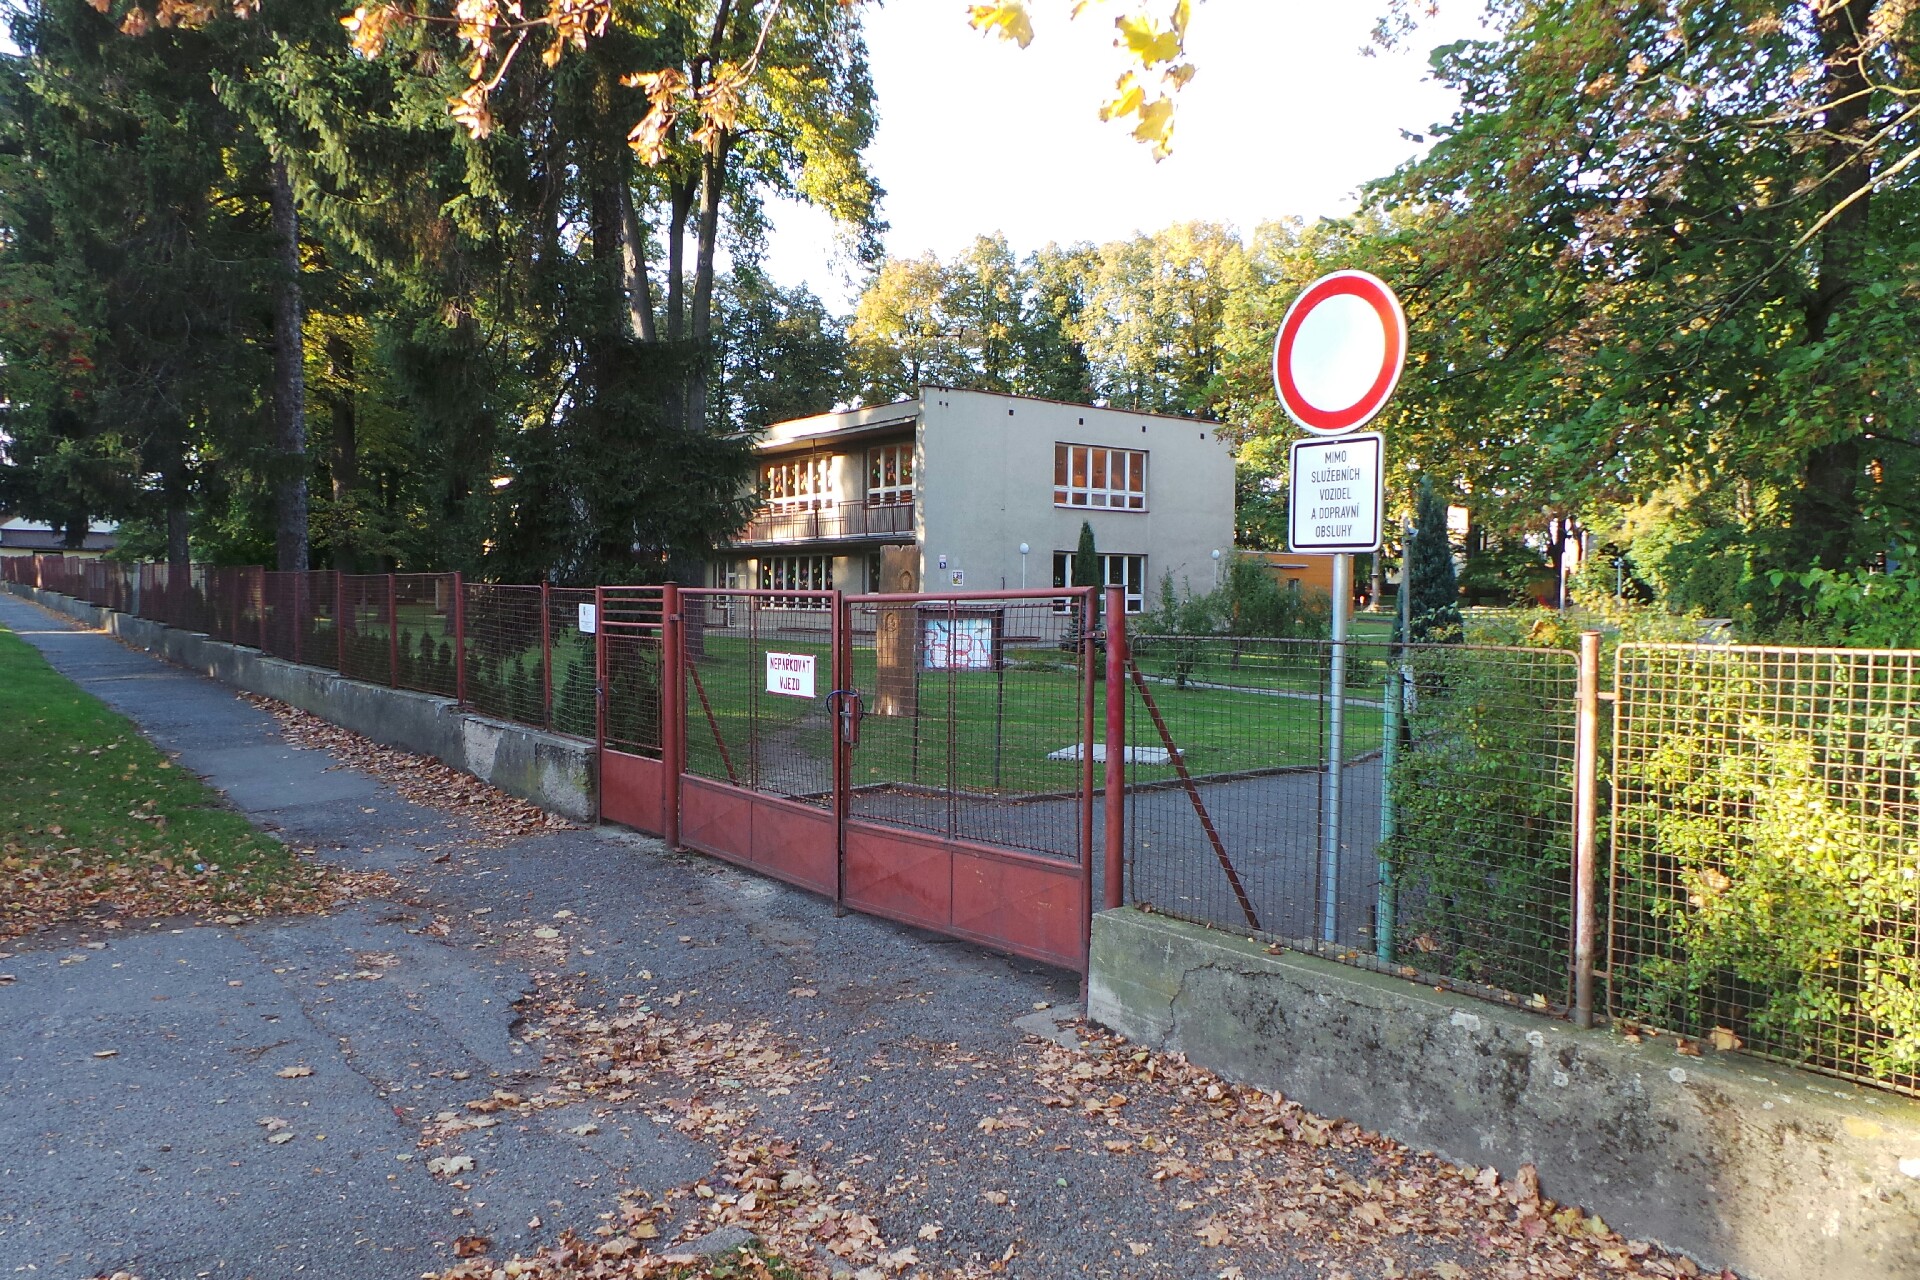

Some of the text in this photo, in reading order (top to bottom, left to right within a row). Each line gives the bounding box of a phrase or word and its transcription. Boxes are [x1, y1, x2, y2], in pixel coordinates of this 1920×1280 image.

[1324, 450, 1347, 464] MIMO
[1311, 466, 1360, 483] SLUŽEBNÍCH
[1319, 488, 1352, 501] VOZIDEL
[1311, 502, 1360, 520] A DOPRAVNÍ
[1315, 525, 1353, 538] OBSLUHY
[770, 657, 811, 673] NEPARKOVAT
[779, 676, 800, 691] VJEZD
